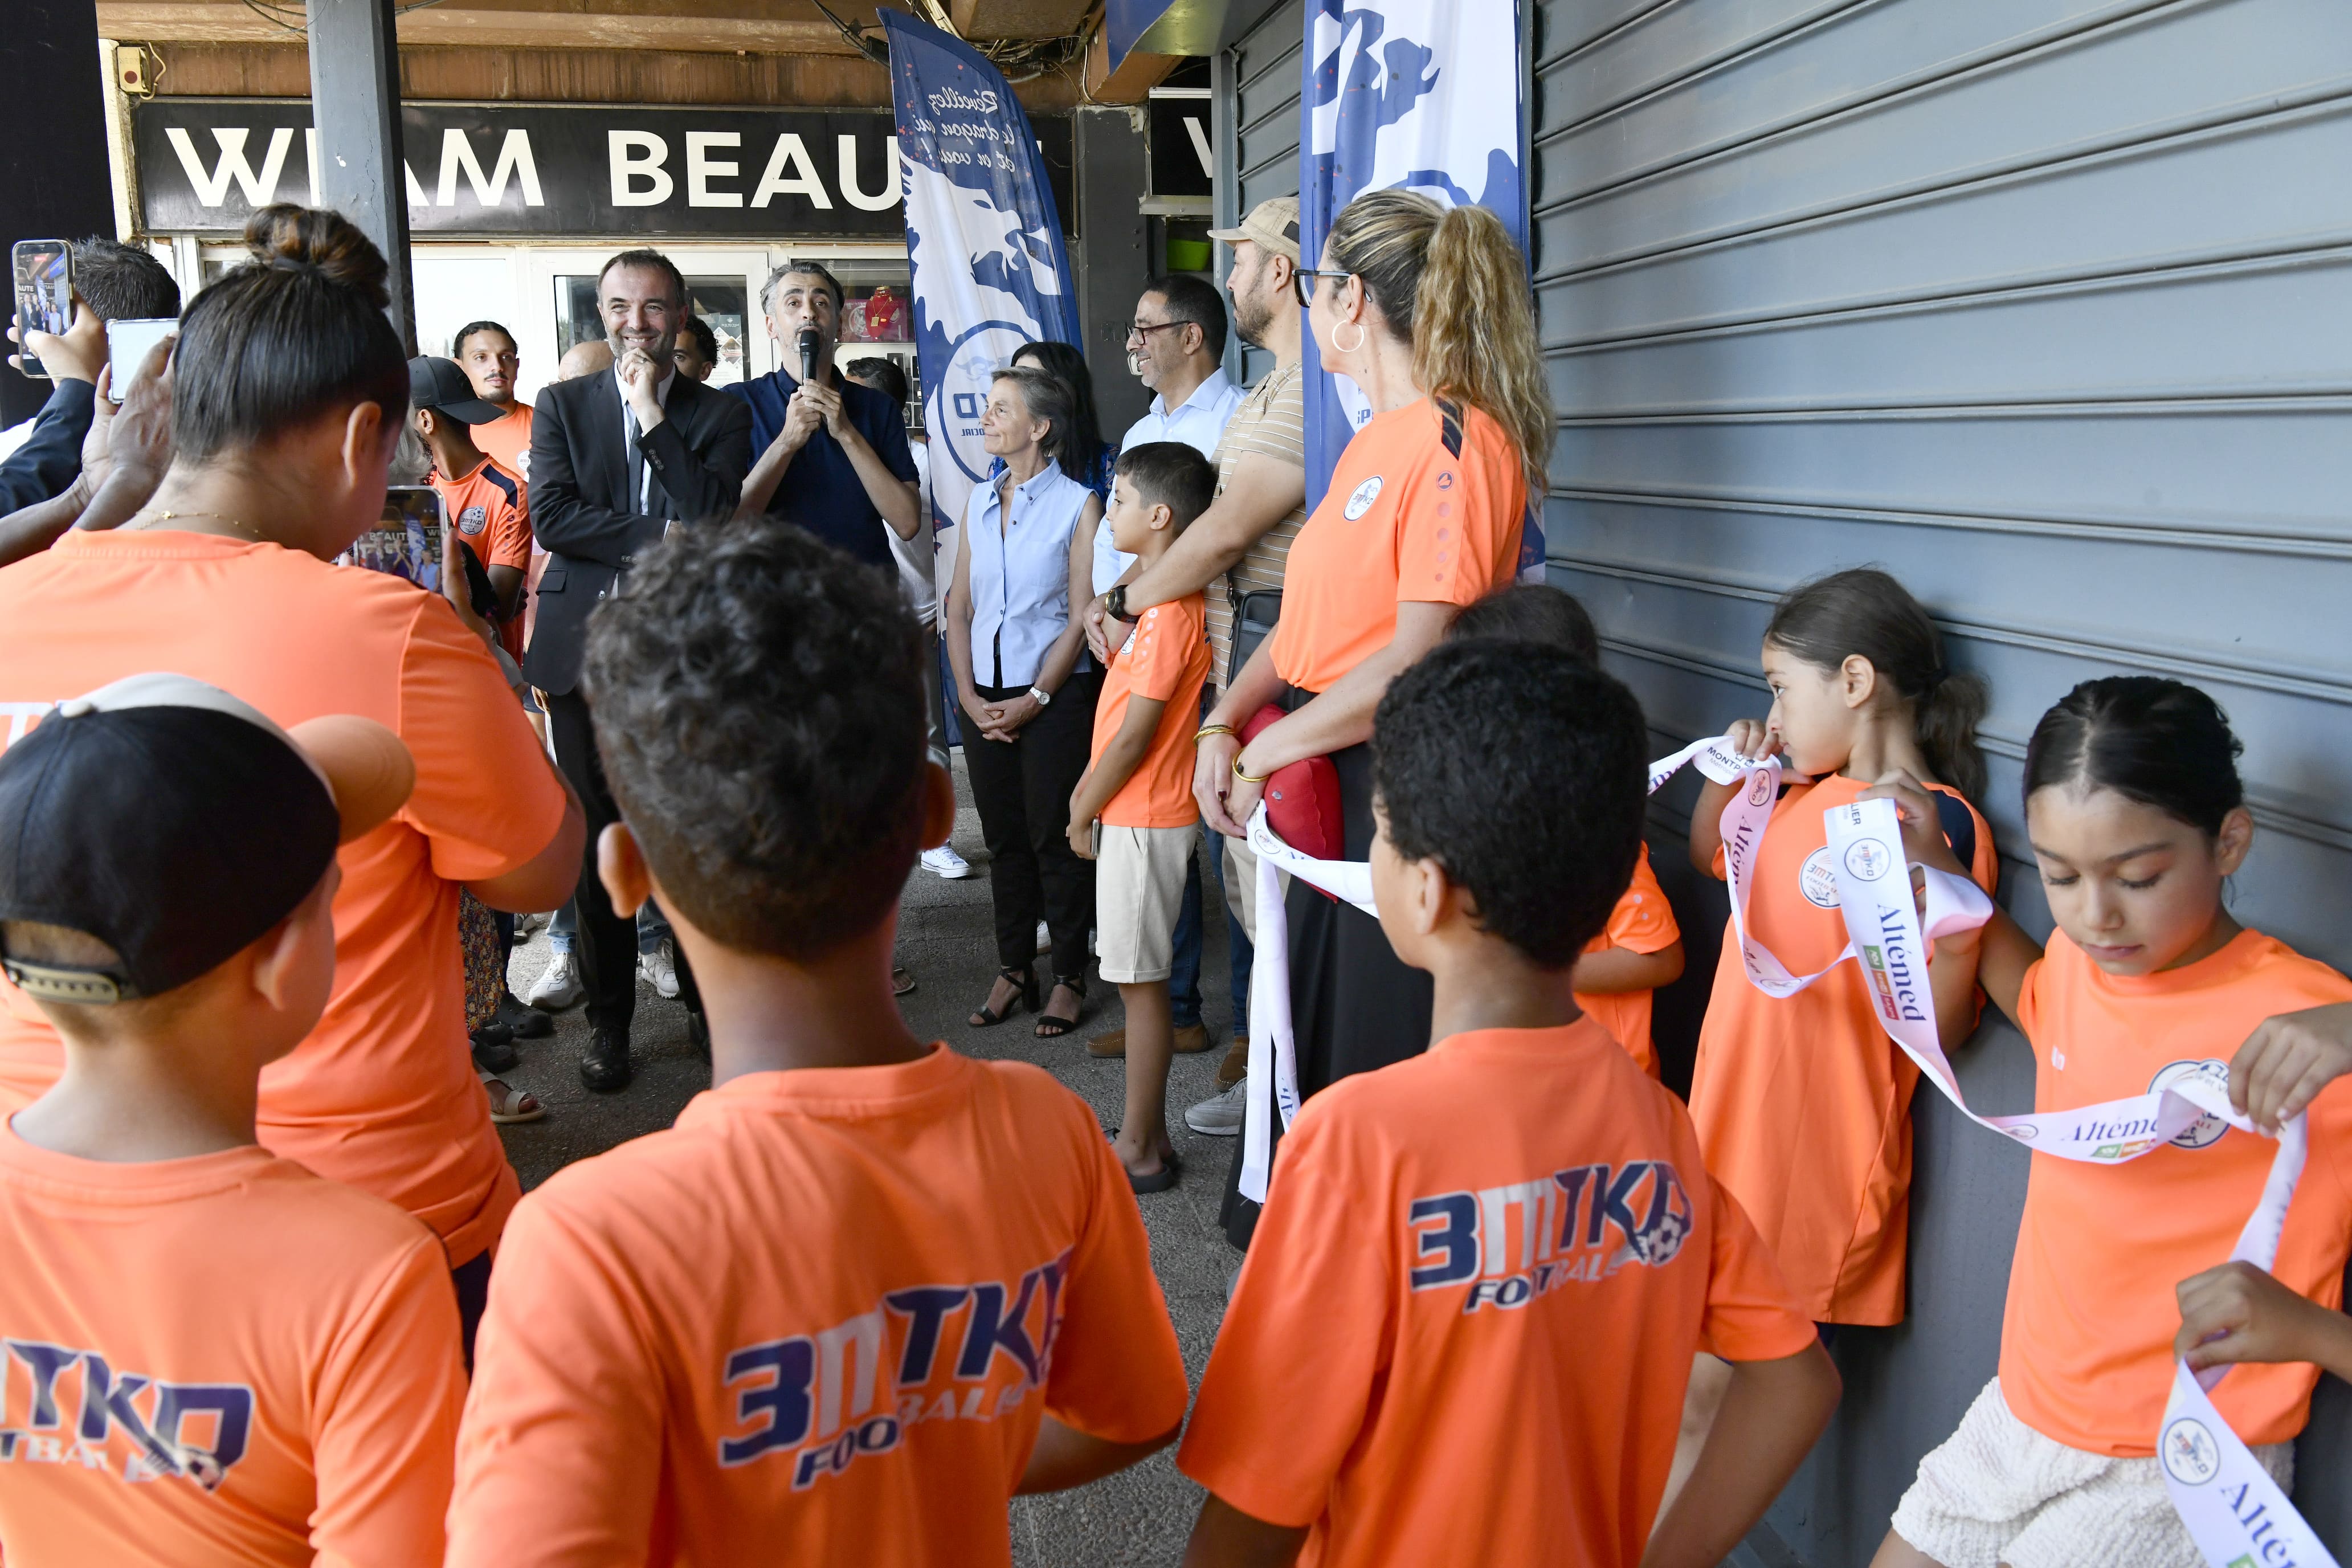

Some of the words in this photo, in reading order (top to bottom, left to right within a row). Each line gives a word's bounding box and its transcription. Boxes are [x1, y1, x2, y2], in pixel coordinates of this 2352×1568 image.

[165, 128, 545, 207] WIM
[608, 130, 904, 211] BEAU
[1851, 803, 1861, 826] LIER
[1807, 863, 1836, 883] 3MT
[1877, 902, 1927, 1022] Altémed
[0, 1337, 256, 1477] TKD
